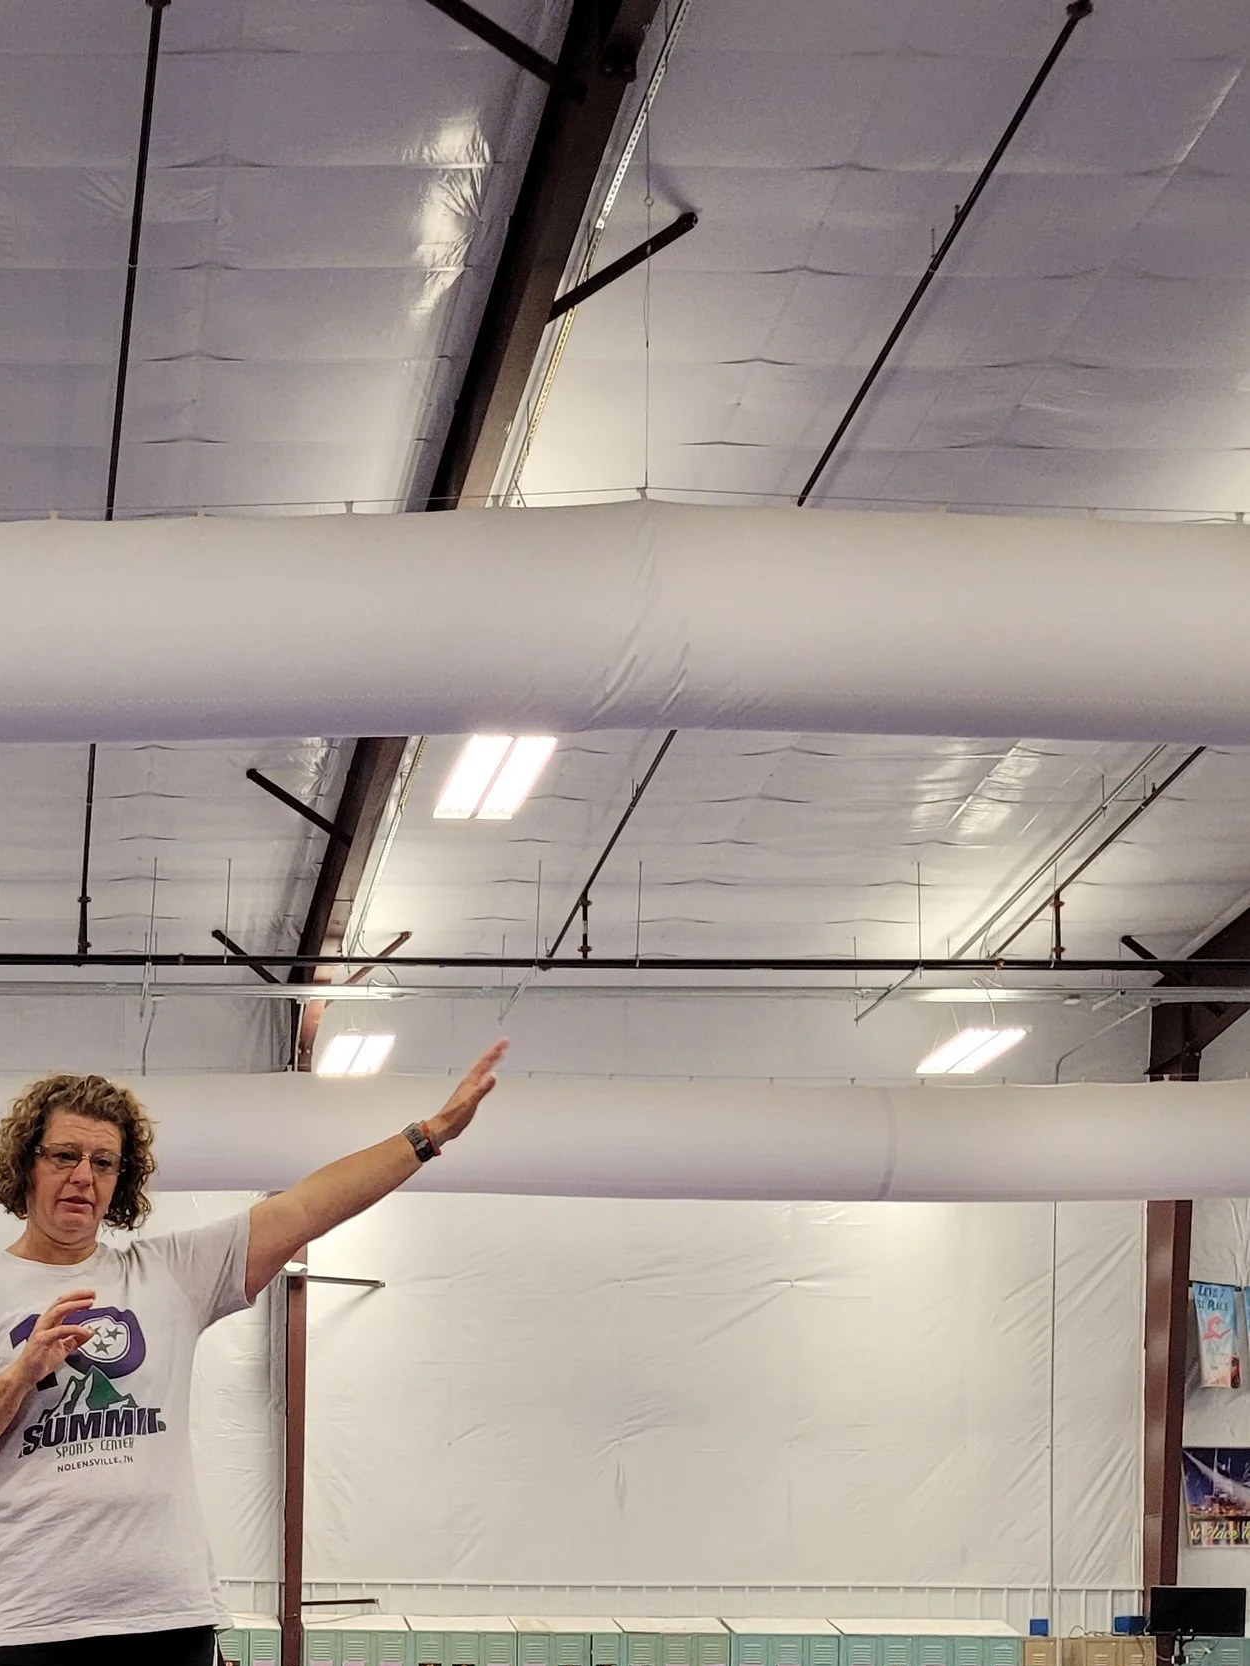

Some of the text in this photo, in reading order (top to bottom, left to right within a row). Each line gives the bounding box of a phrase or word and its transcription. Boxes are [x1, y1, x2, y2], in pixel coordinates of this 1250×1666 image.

[18, 1408, 161, 1458] SUMMIT
[56, 1437, 134, 1459] SPORTS CENTER
